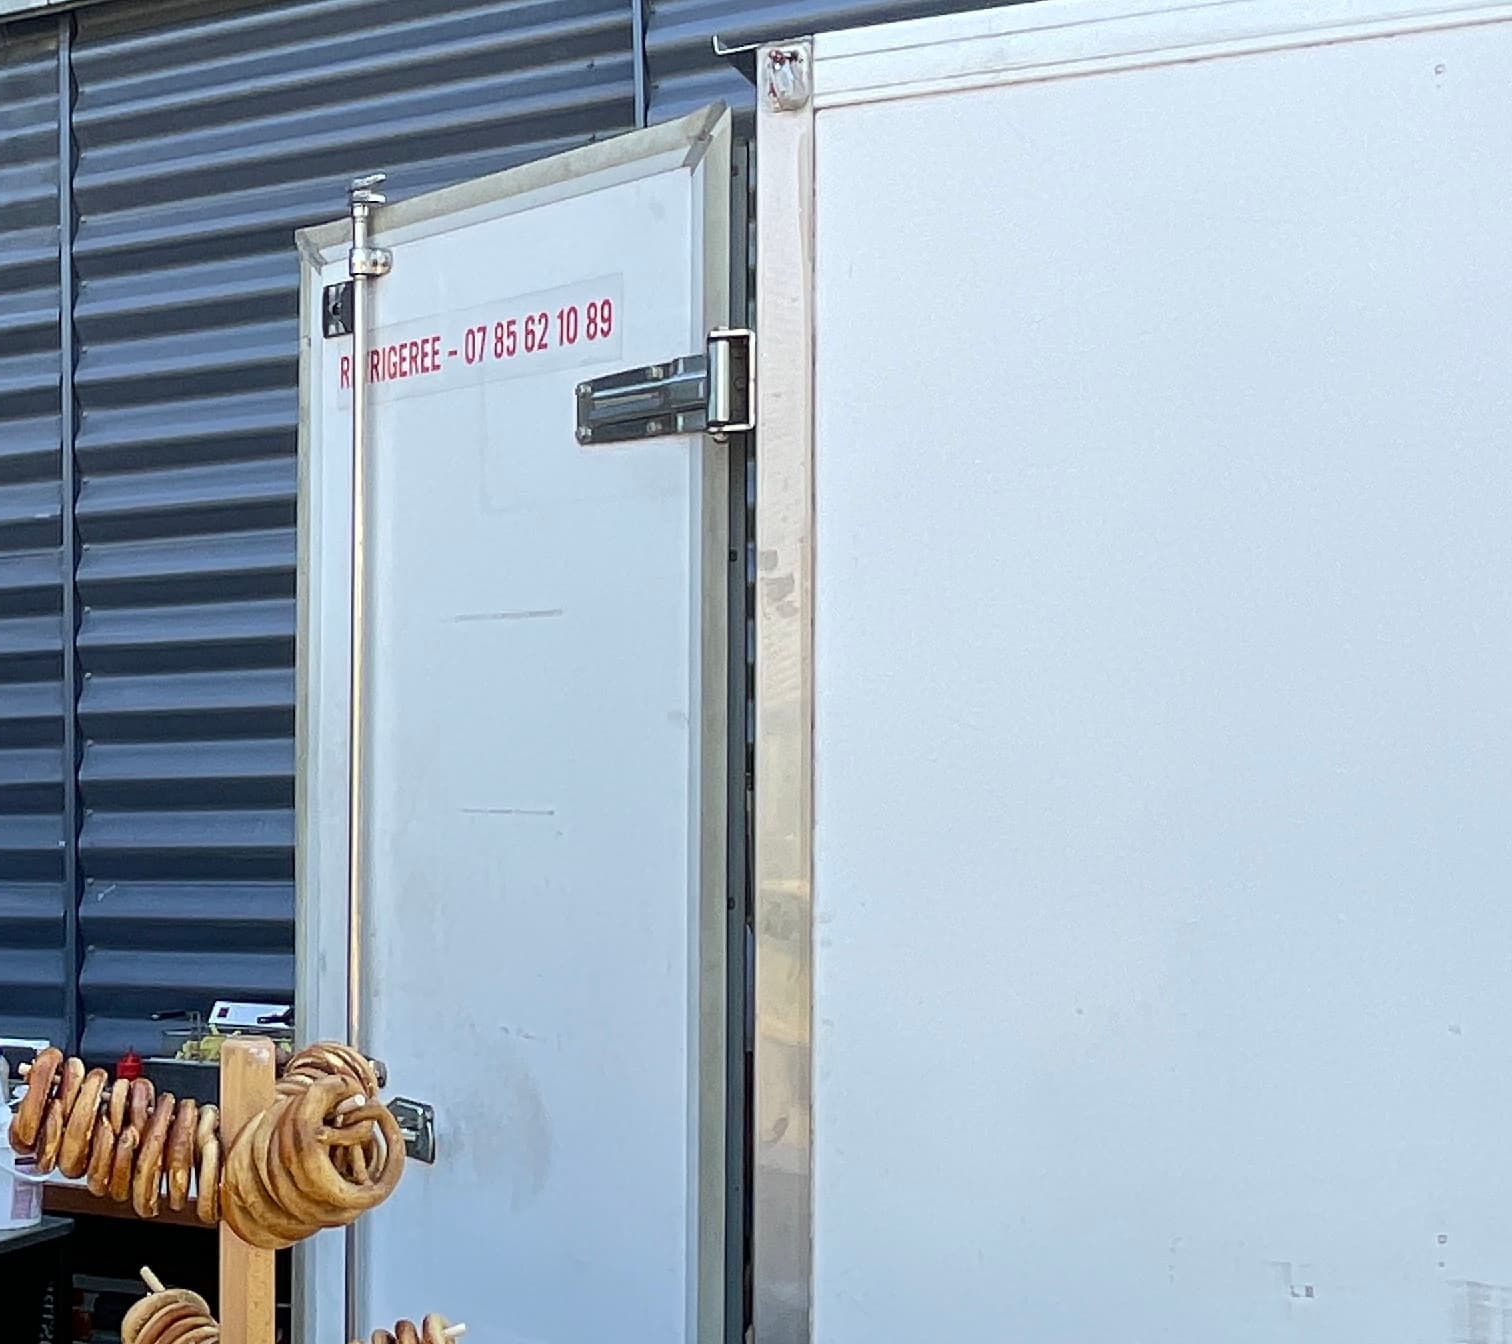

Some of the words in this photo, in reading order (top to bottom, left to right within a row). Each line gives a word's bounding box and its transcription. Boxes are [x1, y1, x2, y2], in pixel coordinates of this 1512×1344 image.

[340, 336, 441, 390] RRIGEREE
[464, 325, 487, 364] 07
[494, 319, 517, 359] 85
[524, 312, 548, 353] 62
[557, 306, 578, 346] 10
[586, 299, 612, 340] 89
